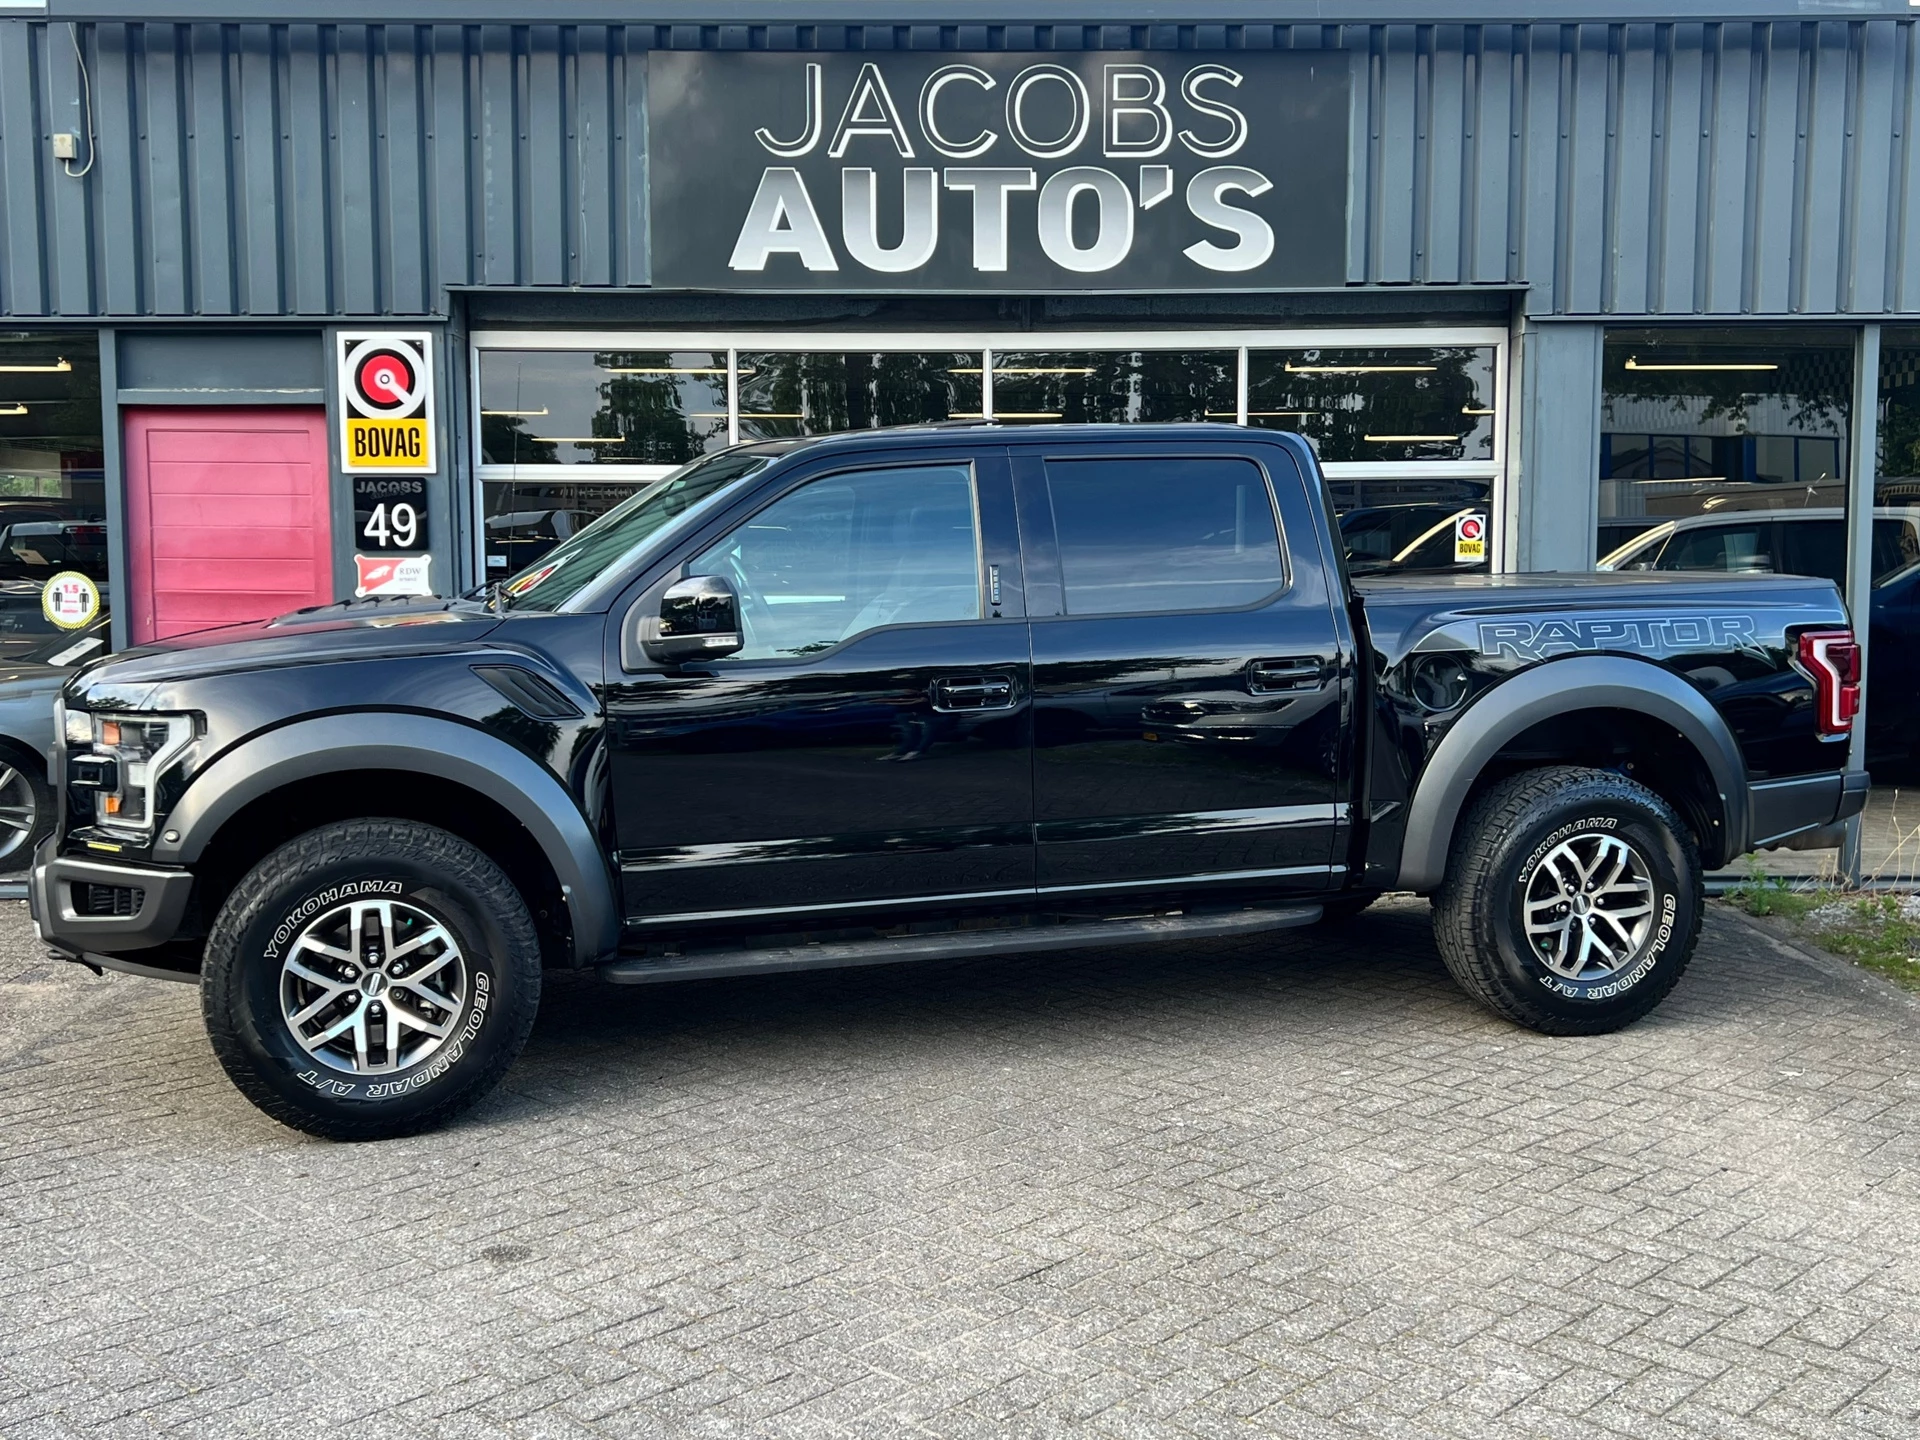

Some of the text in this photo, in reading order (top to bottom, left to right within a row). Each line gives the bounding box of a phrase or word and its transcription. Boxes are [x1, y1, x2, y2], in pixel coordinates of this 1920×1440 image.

[754, 63, 1248, 158] JACOBS
[727, 165, 1275, 273] AUTO'S
[354, 427, 420, 458] BOVAG
[356, 481, 422, 494] JACOBS
[364, 503, 417, 547] 49
[1459, 543, 1481, 553] BOVAG
[399, 567, 421, 575] RDW
[1478, 614, 1777, 669] RAPTOR
[1518, 817, 1618, 883] YOKOHAMA
[263, 880, 403, 959] YOKOHAMA
[1540, 893, 1676, 999] GEOLANDAR A/T
[297, 971, 490, 1098] GEOLANDAR A/T
